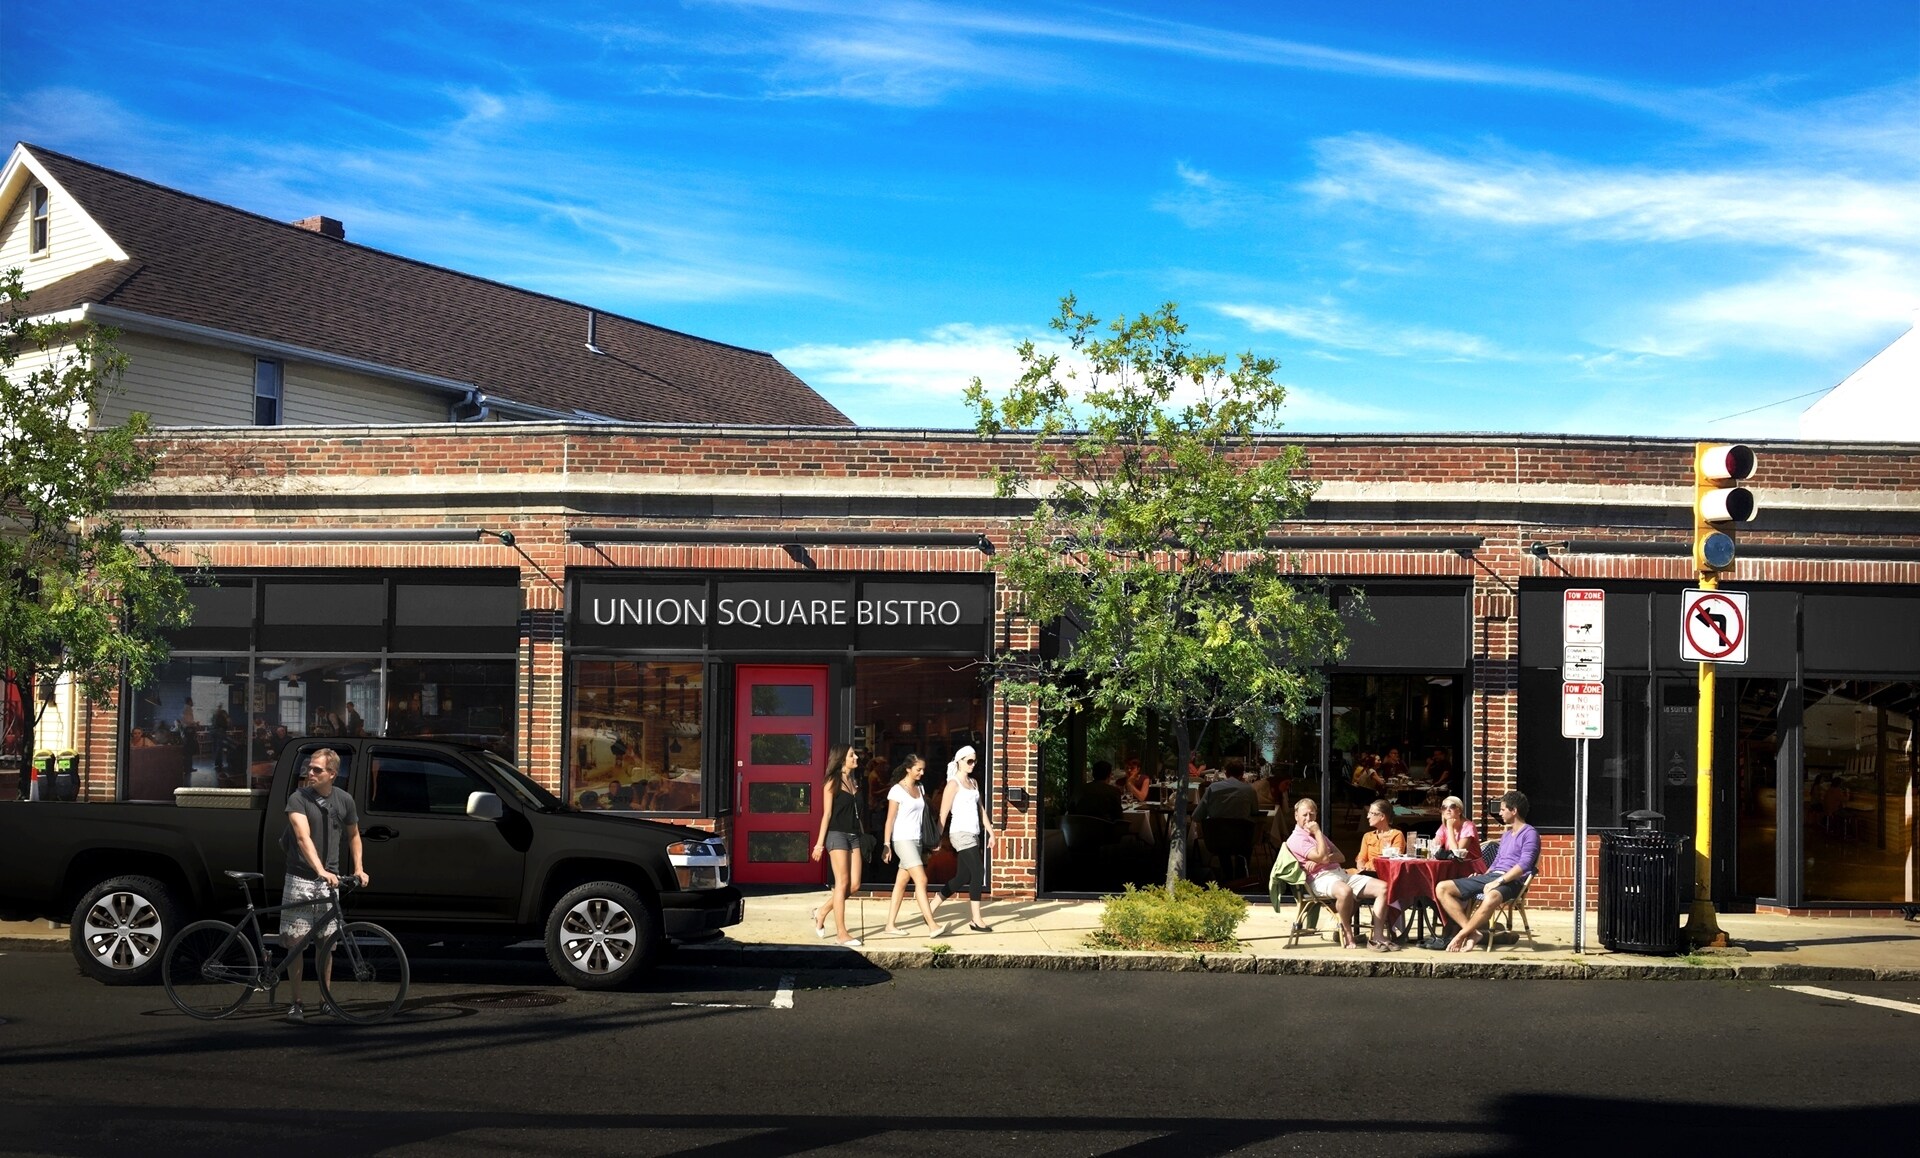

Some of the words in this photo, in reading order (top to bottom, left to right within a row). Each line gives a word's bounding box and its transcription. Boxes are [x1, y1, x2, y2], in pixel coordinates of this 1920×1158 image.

[594, 598, 707, 625] UNION
[718, 599, 847, 628] SQUARE
[857, 600, 961, 625] BISTRO
[1565, 685, 1580, 693] TOW
[1582, 685, 1602, 693] ZONE
